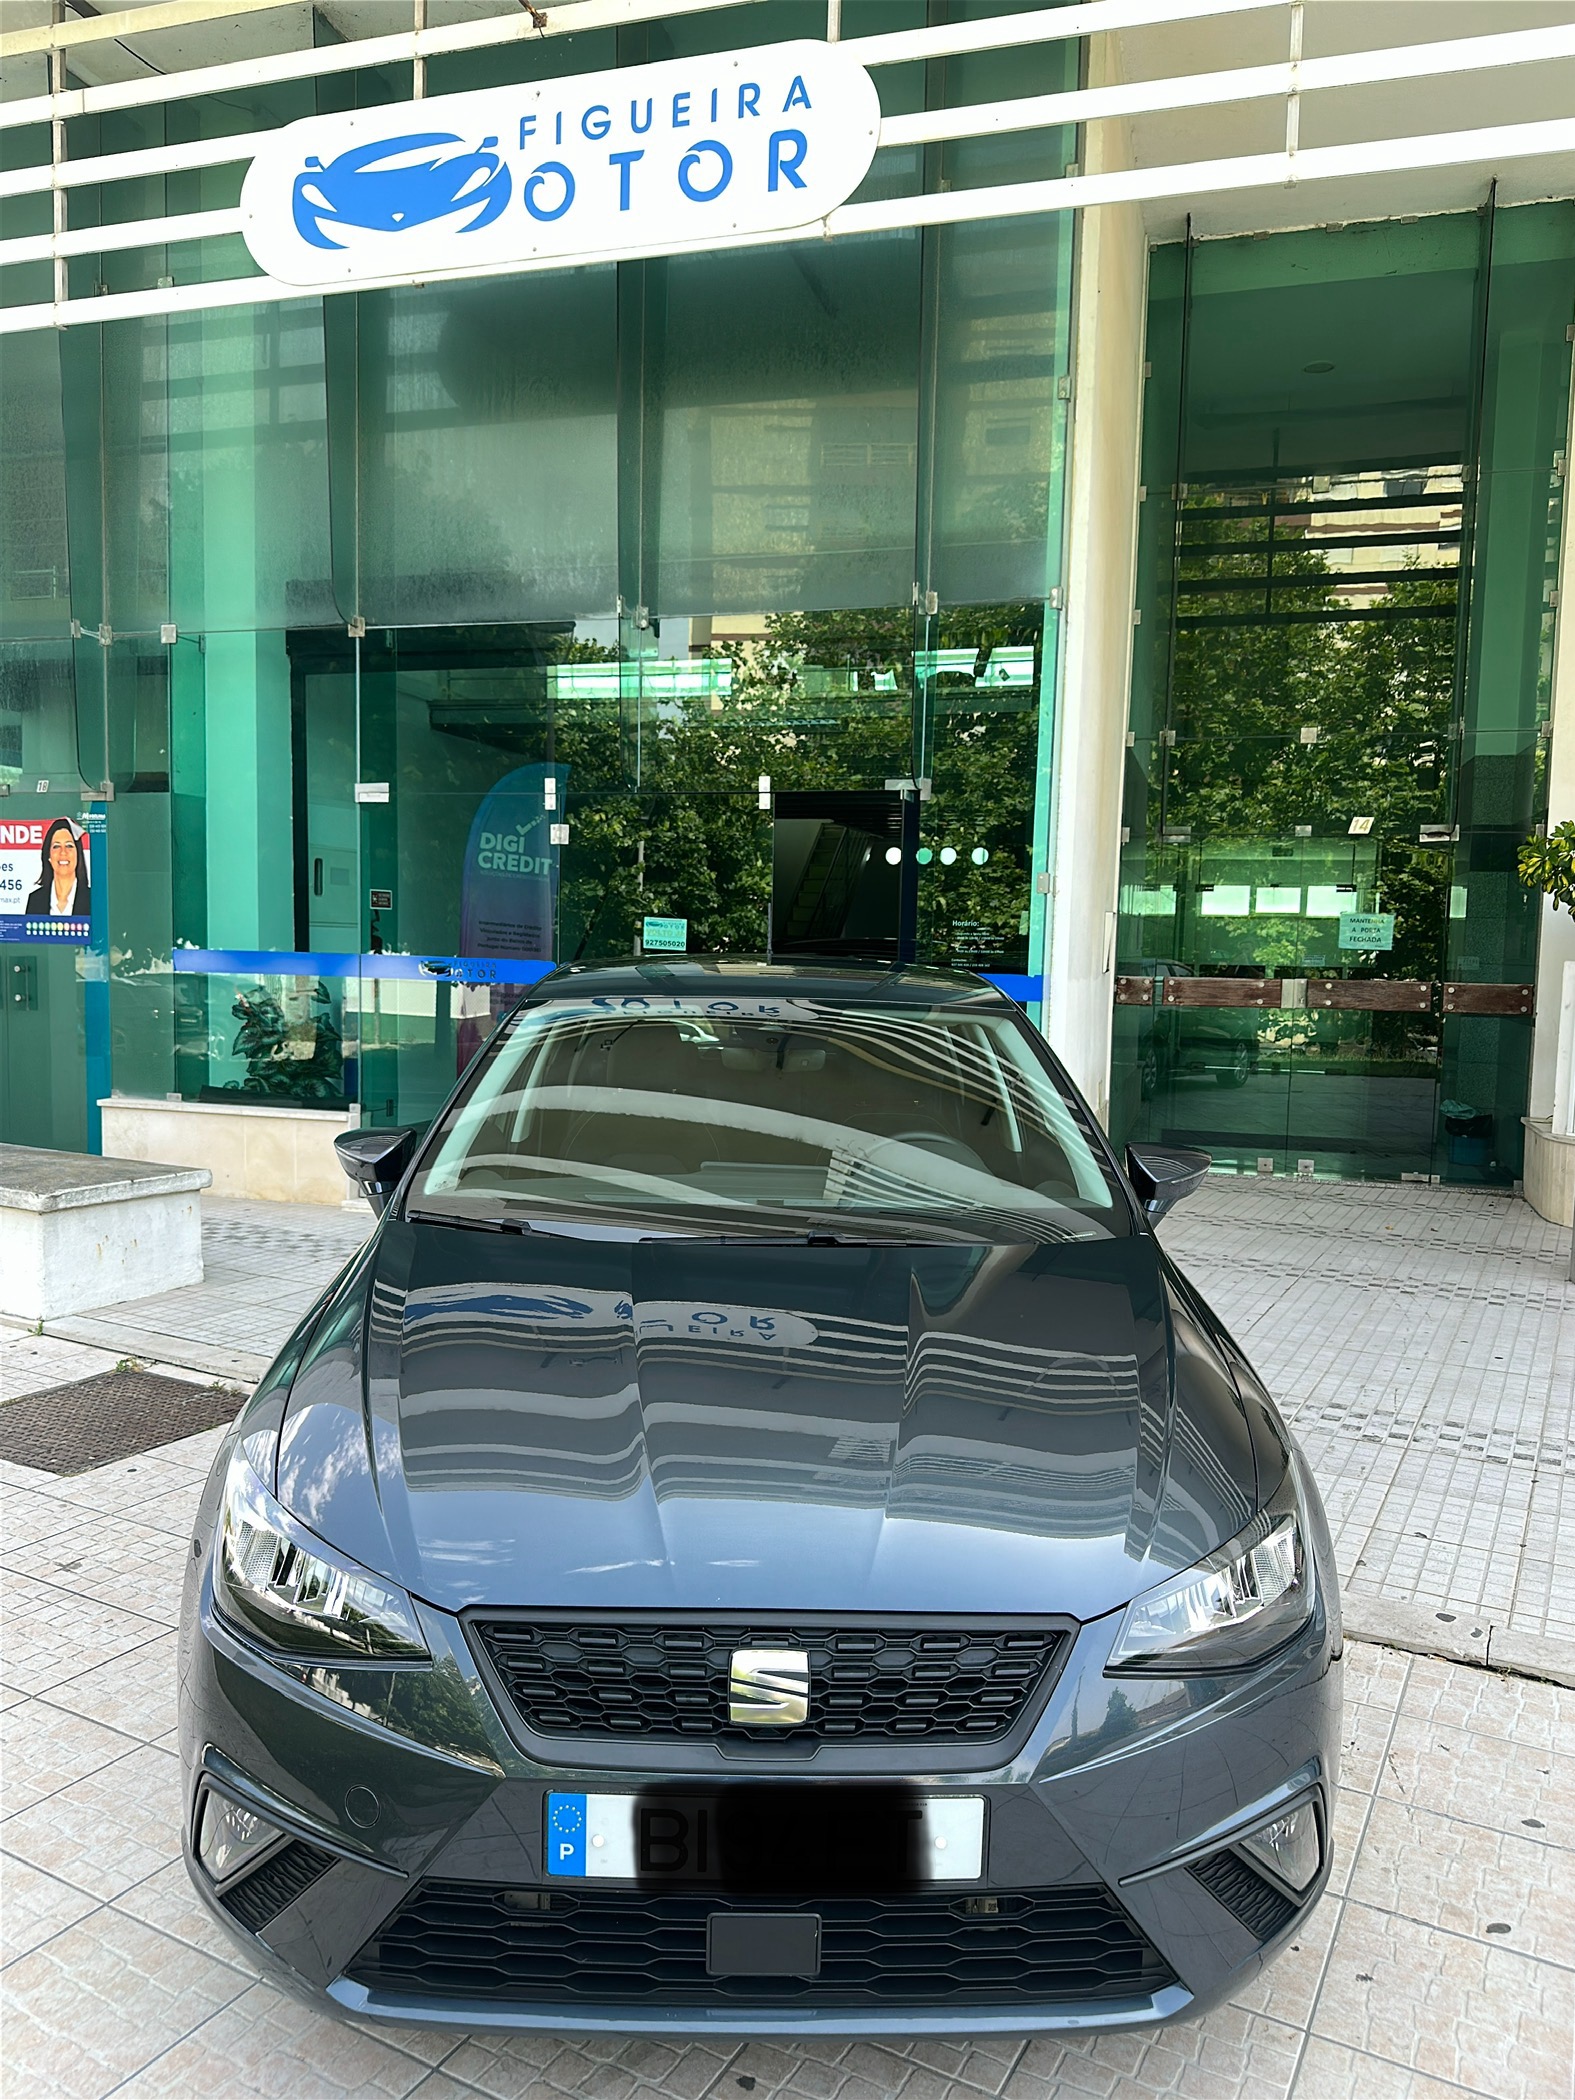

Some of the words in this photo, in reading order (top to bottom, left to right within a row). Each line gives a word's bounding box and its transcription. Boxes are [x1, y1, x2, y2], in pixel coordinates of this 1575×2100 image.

[519, 75, 812, 150] FIGUEIRA
[524, 129, 808, 222] OTOR
[38, 781, 48, 792] 18
[1353, 818, 1371, 832] 14
[479, 832, 525, 854] DIGI
[477, 851, 553, 875] CREDIT
[645, 939, 686, 948] 927505020
[559, 1843, 574, 1861] P
